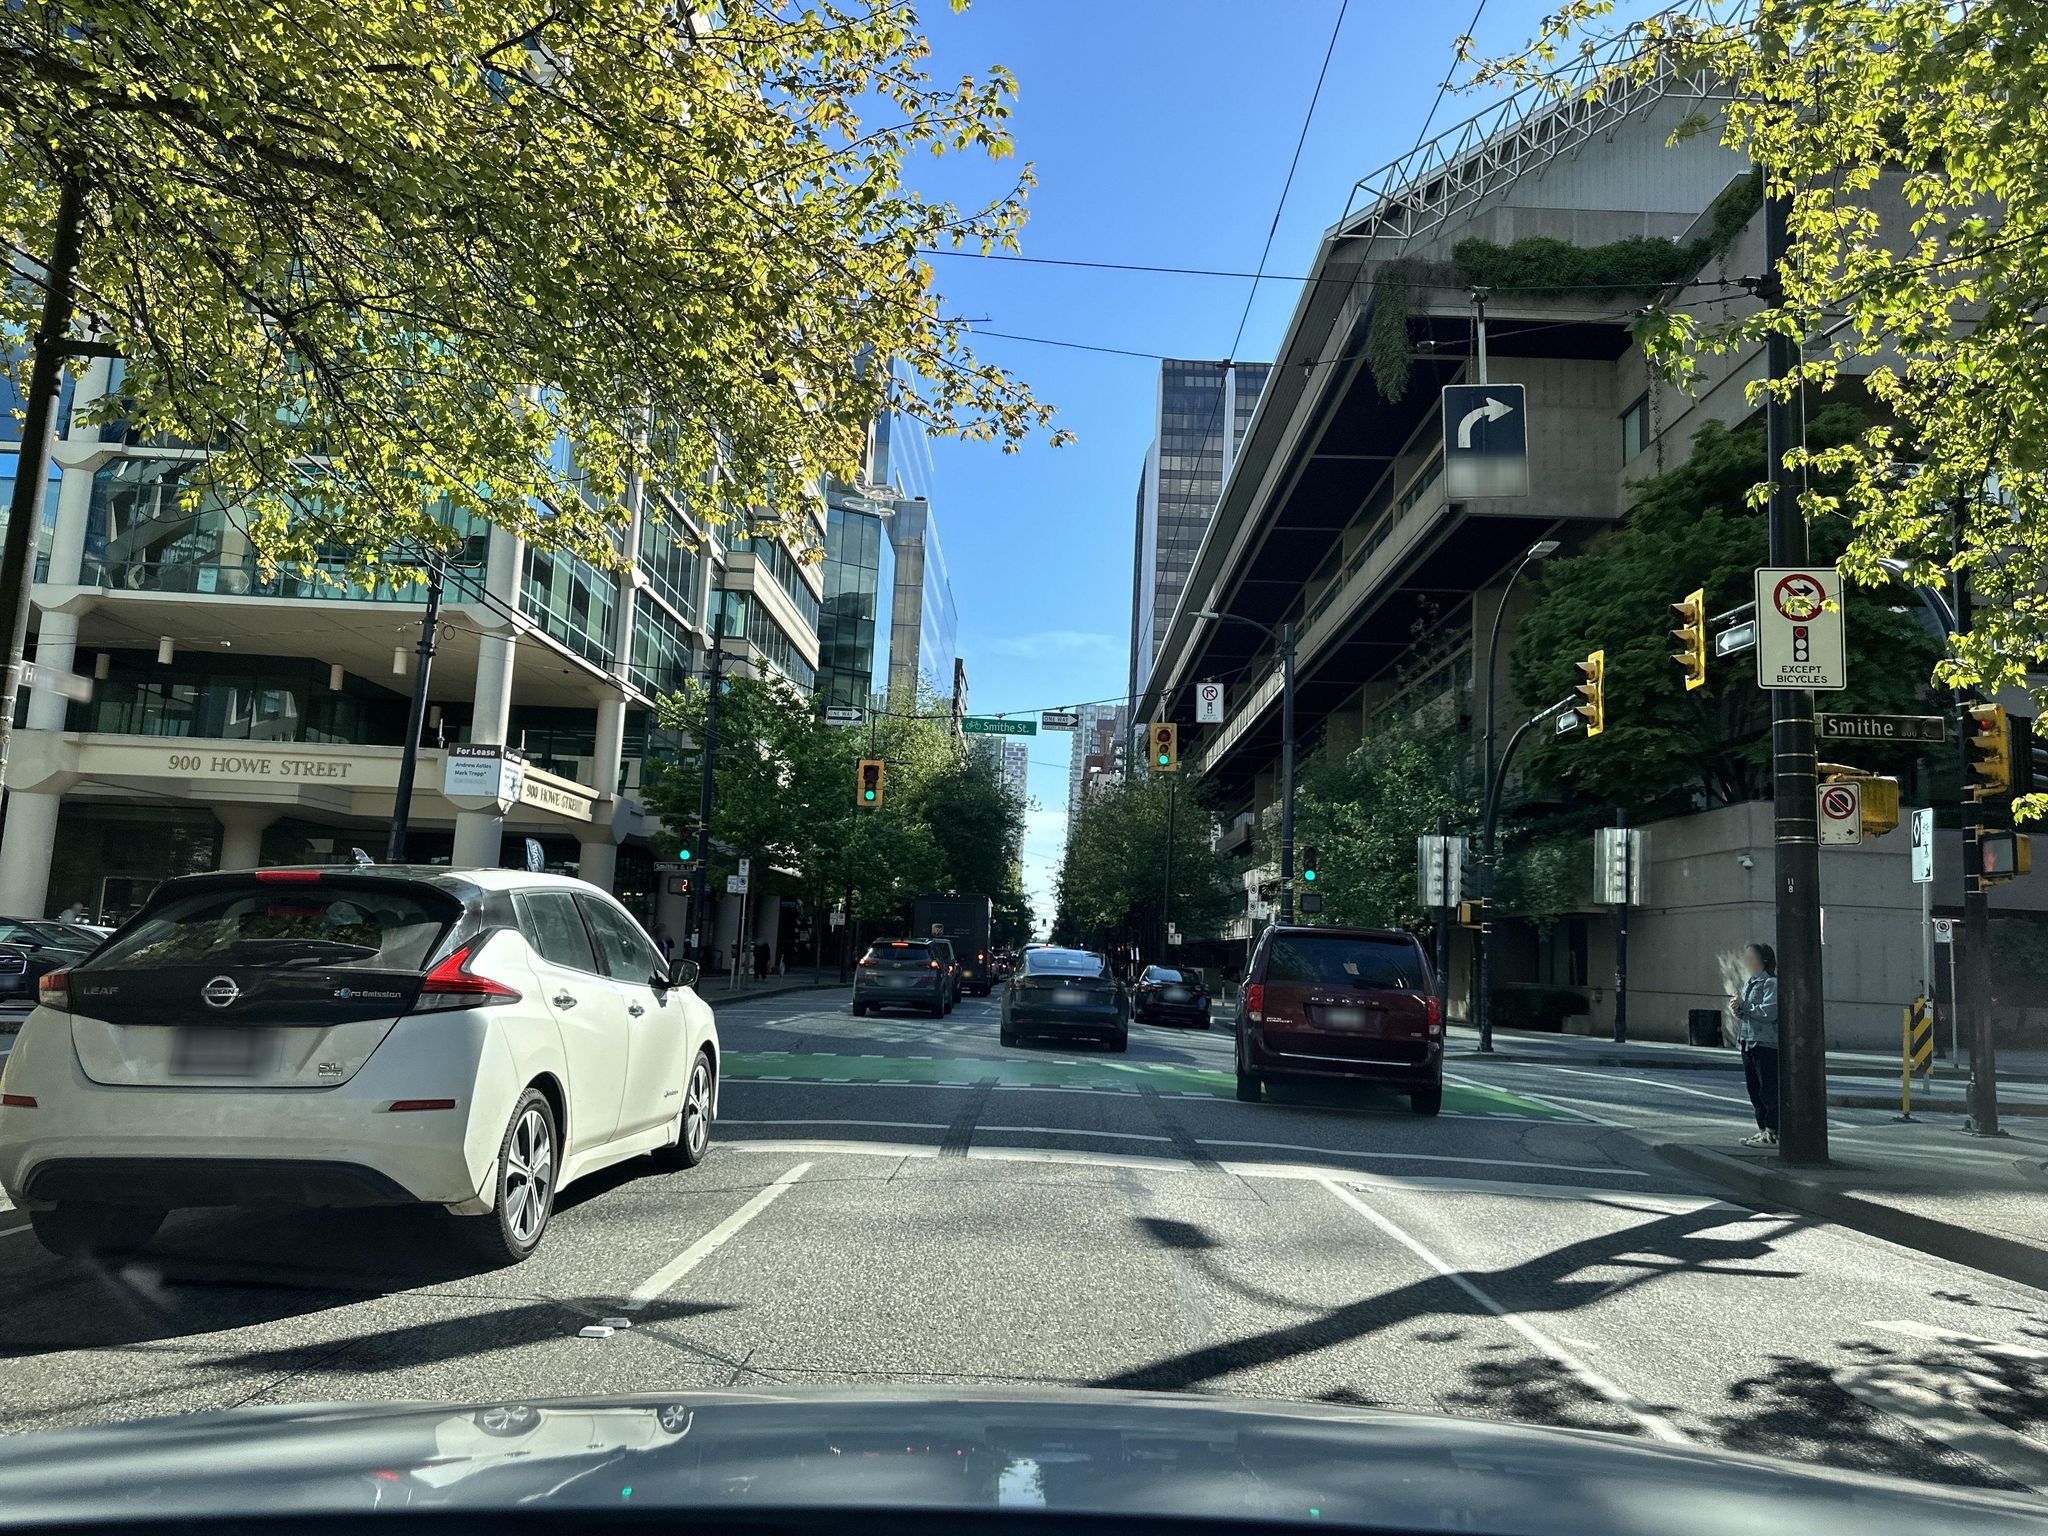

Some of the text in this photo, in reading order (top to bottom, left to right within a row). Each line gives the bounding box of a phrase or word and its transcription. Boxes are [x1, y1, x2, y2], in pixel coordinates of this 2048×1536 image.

[1781, 665, 1822, 674] EXCEPT
[1776, 675, 1828, 684] BICYCLES
[983, 721, 1030, 733] Smithe St.
[1828, 718, 1894, 737] Smithe
[456, 747, 496, 756] For Lease
[168, 754, 352, 778] 900 HOWE STREET
[526, 783, 583, 812] 900 HOWE STRE
[681, 879, 688, 892] 2
[83, 986, 119, 995] LEAF
